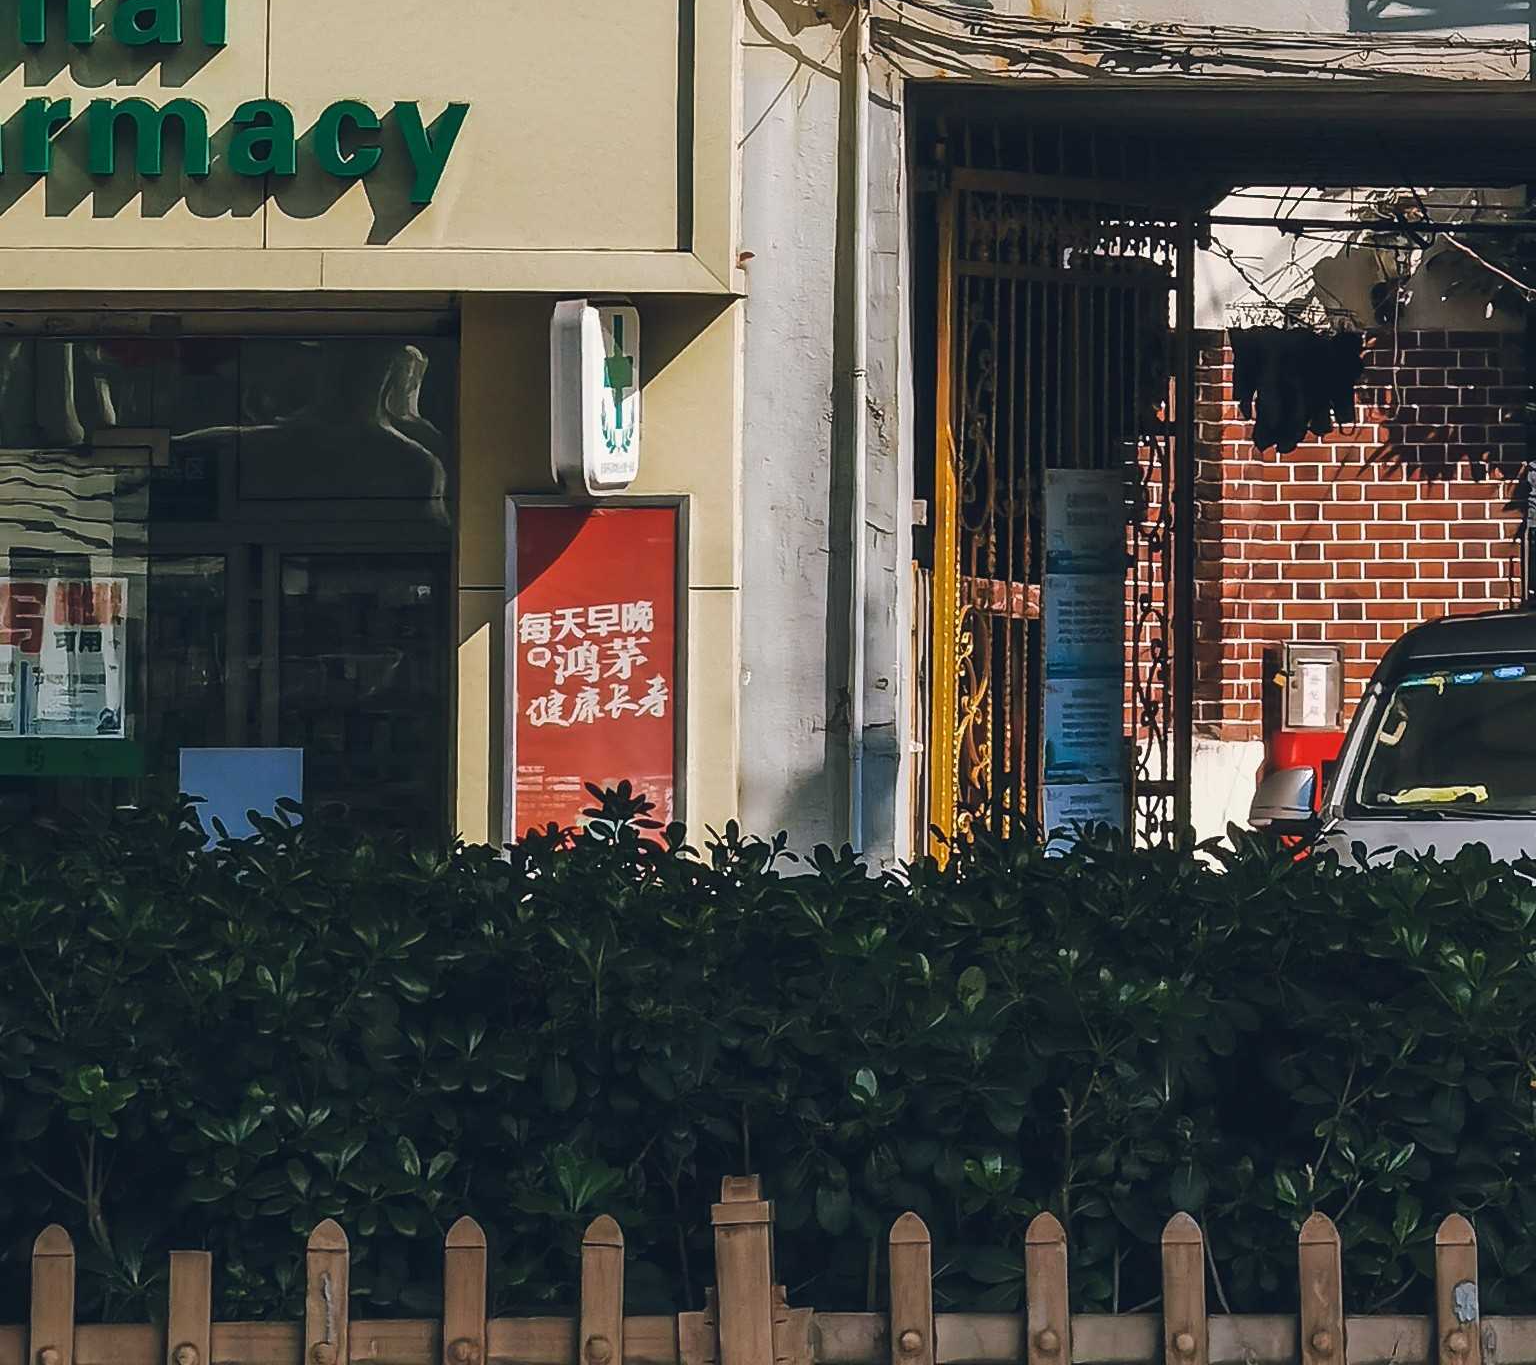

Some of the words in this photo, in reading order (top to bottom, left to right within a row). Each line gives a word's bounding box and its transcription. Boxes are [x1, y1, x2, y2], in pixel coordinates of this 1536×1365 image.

[0, 97, 469, 205] rmacy
[519, 600, 654, 645] 每天早晚
[525, 673, 669, 727] 健康长寿
